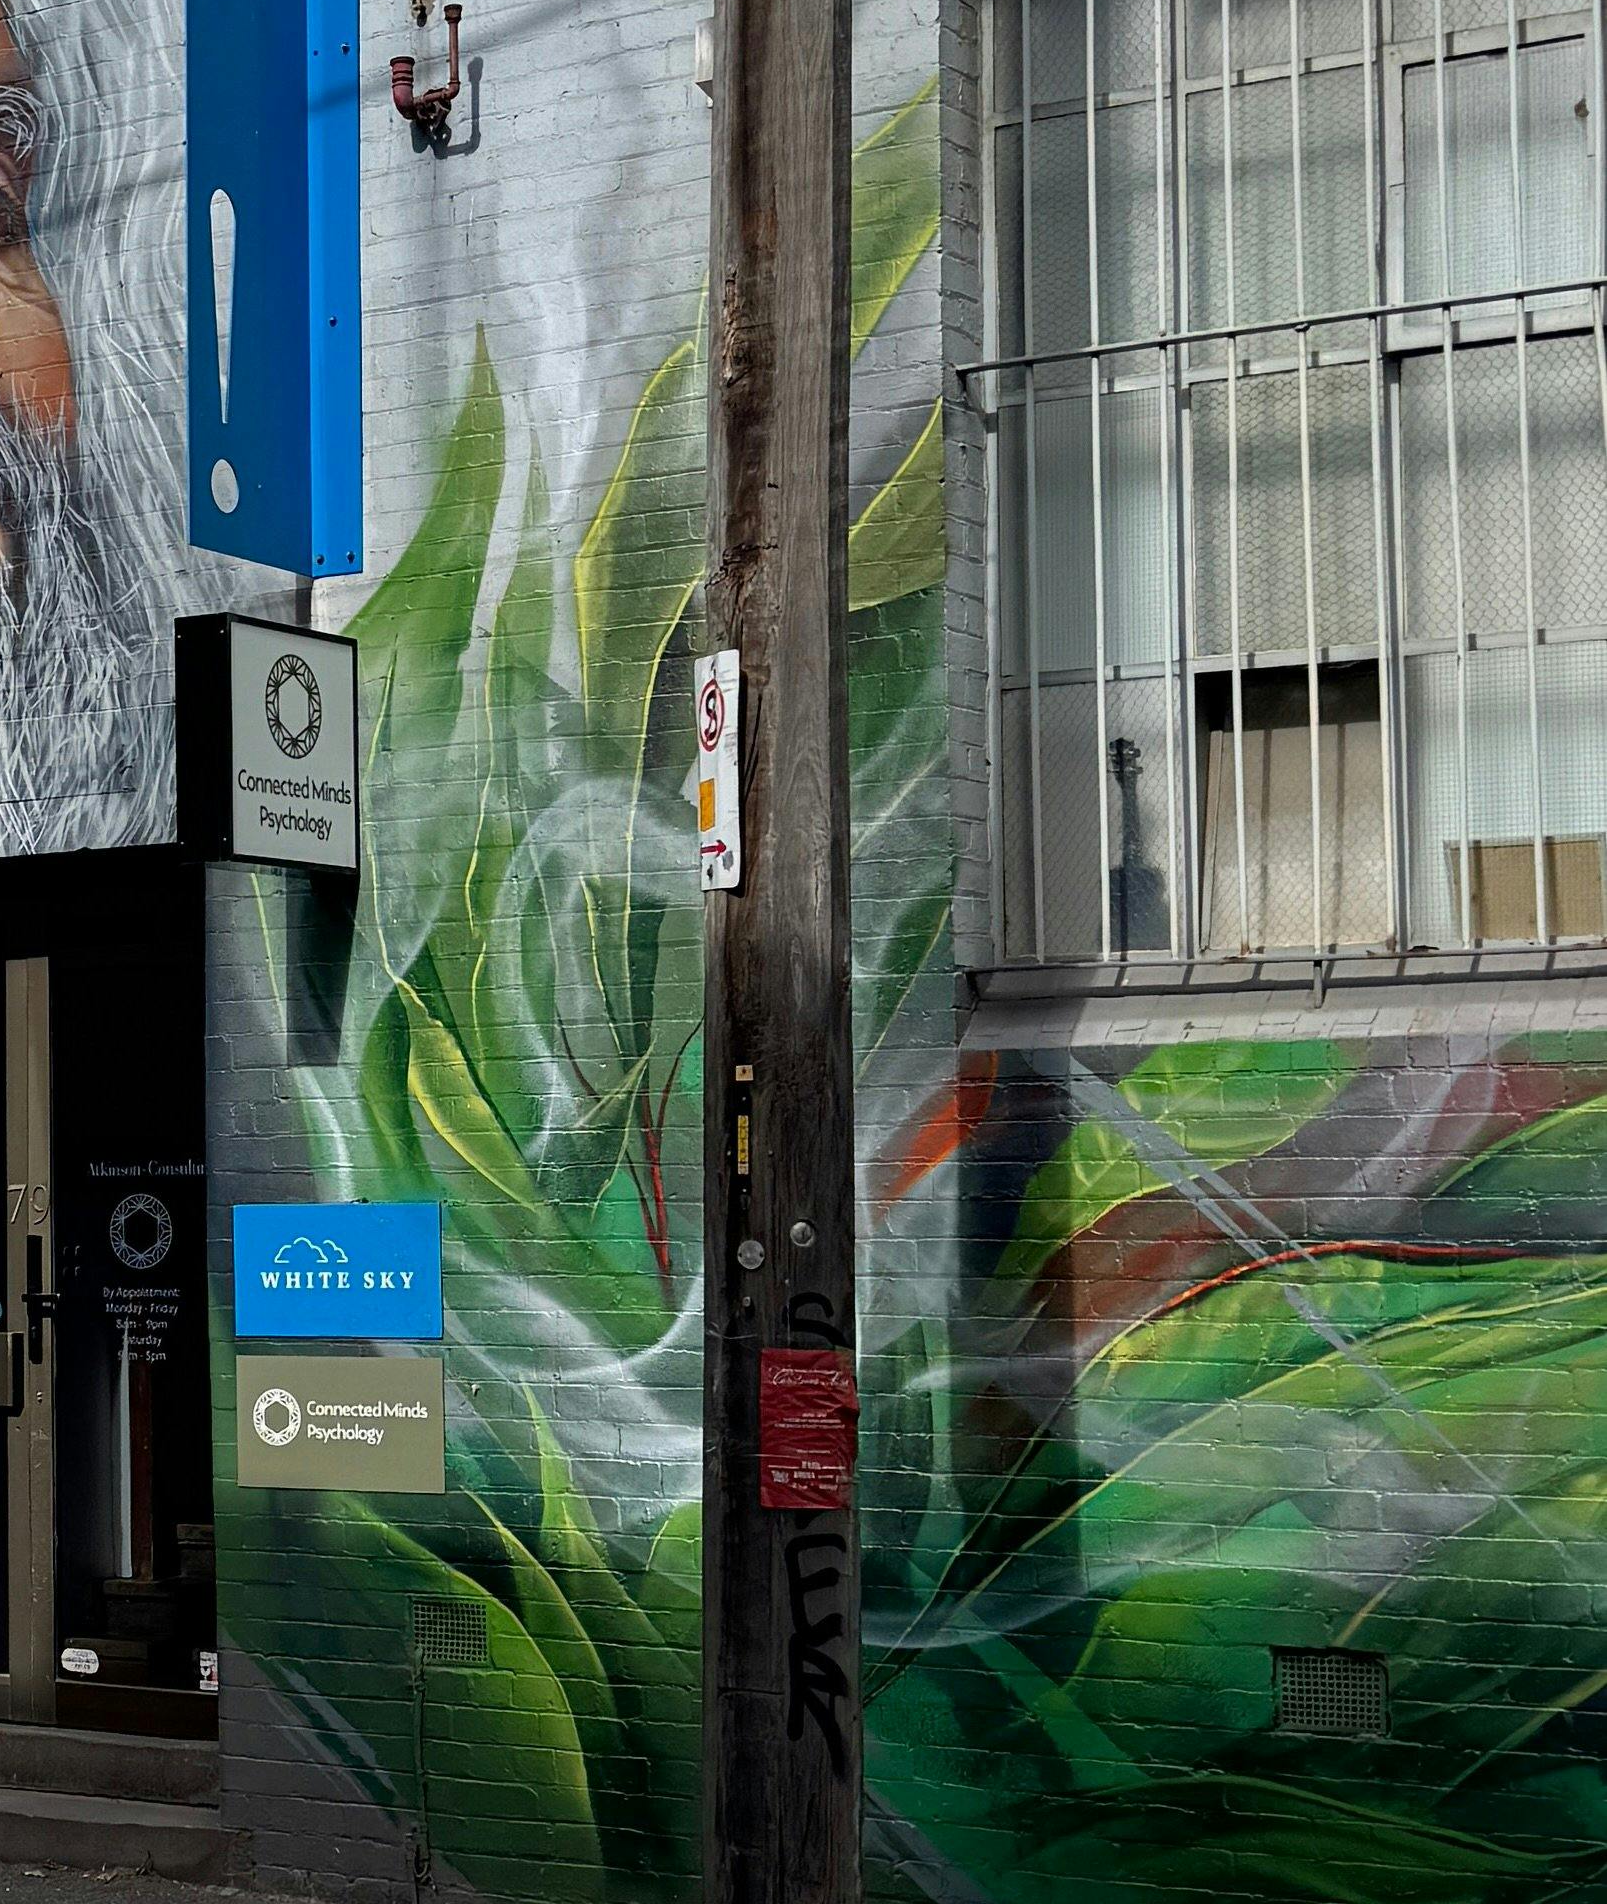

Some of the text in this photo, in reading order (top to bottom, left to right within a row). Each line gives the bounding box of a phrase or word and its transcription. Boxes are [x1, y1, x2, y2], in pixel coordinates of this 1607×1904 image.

[237, 768, 352, 805] Connected Minds
[259, 805, 333, 841] Psychology
[7, 1184, 50, 1225] 79
[260, 1271, 415, 1290] WHITE SKY
[306, 1400, 429, 1420] Connected Minds
[307, 1423, 385, 1445] Psychology
